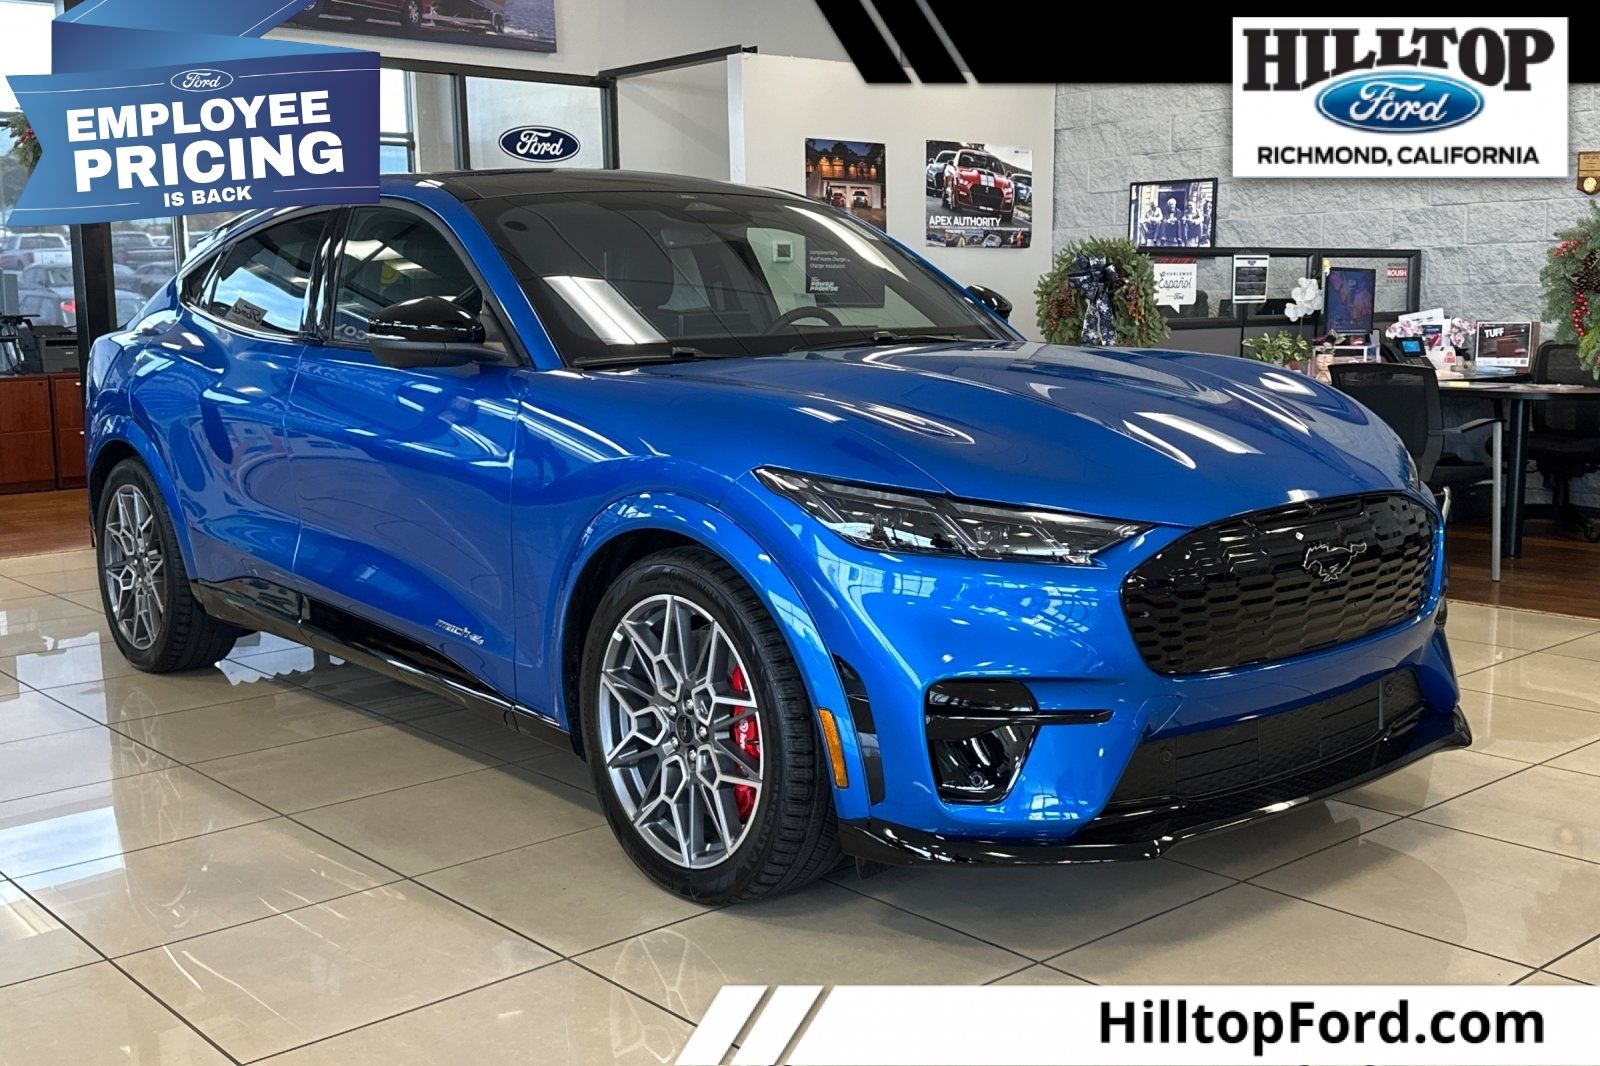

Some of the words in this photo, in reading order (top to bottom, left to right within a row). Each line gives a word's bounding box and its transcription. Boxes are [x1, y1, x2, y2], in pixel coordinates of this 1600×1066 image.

[515, 130, 564, 155] Ford
[929, 215, 952, 226] APEX
[953, 216, 1002, 227] AUTHORITY
[1484, 327, 1505, 339] TUFF
